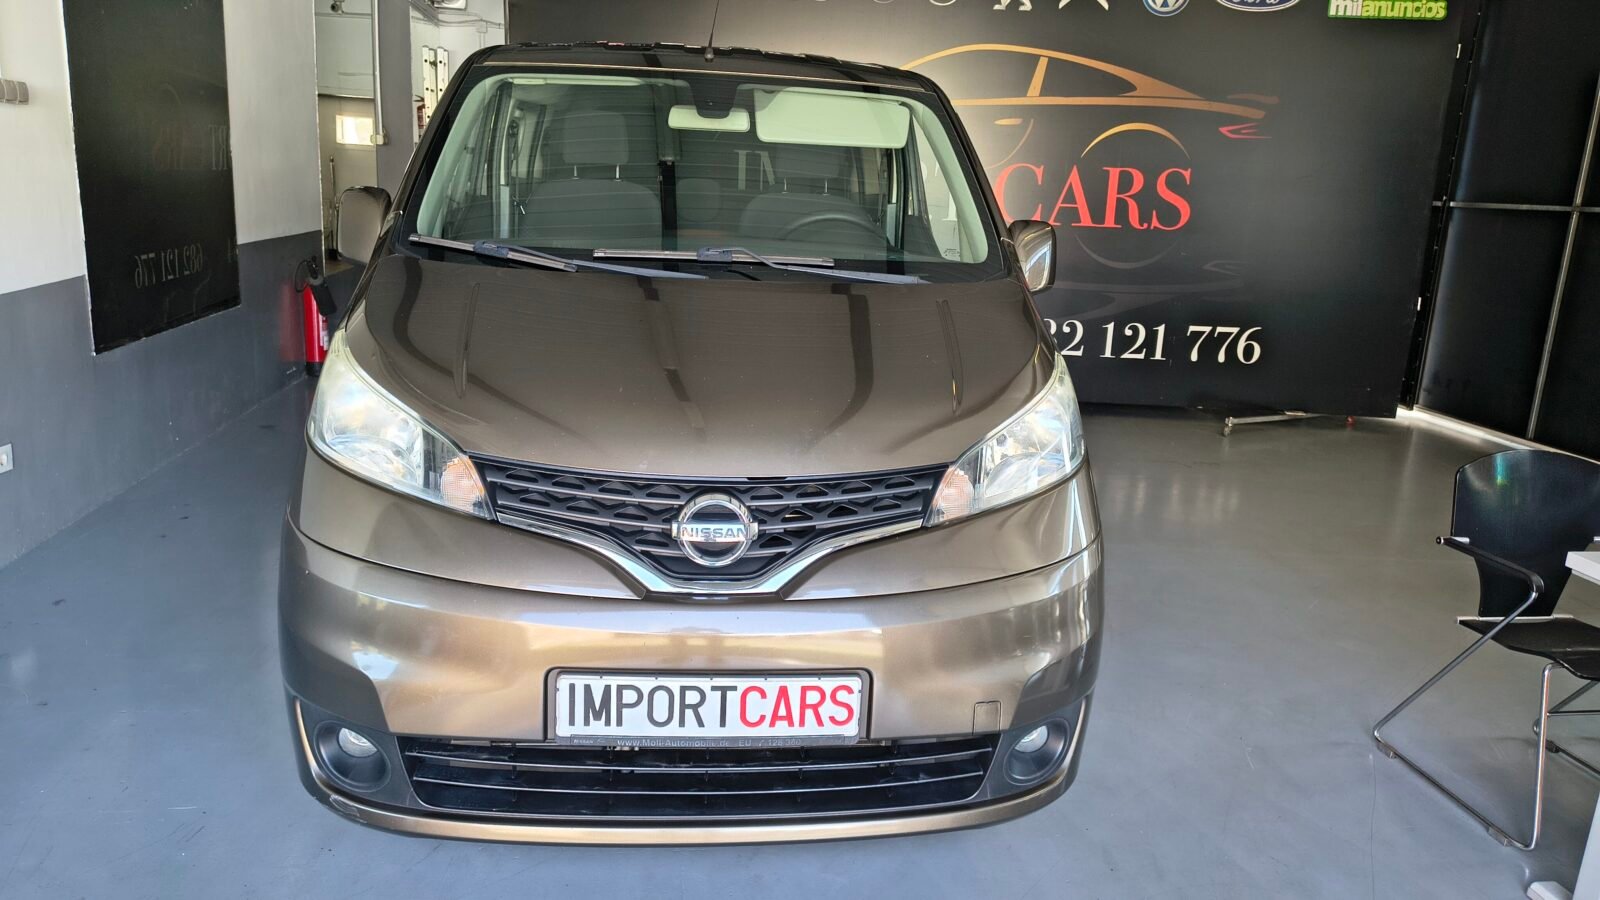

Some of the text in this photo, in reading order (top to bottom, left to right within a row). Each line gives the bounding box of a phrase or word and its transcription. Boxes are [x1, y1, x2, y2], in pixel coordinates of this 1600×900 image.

[1329, 0, 1446, 18] milanuncios
[993, 163, 1192, 231] CARS
[1099, 321, 1167, 361] 121
[1186, 325, 1263, 364] 776
[681, 527, 748, 539] NISSAN
[568, 682, 855, 728] IMPORTCARS
